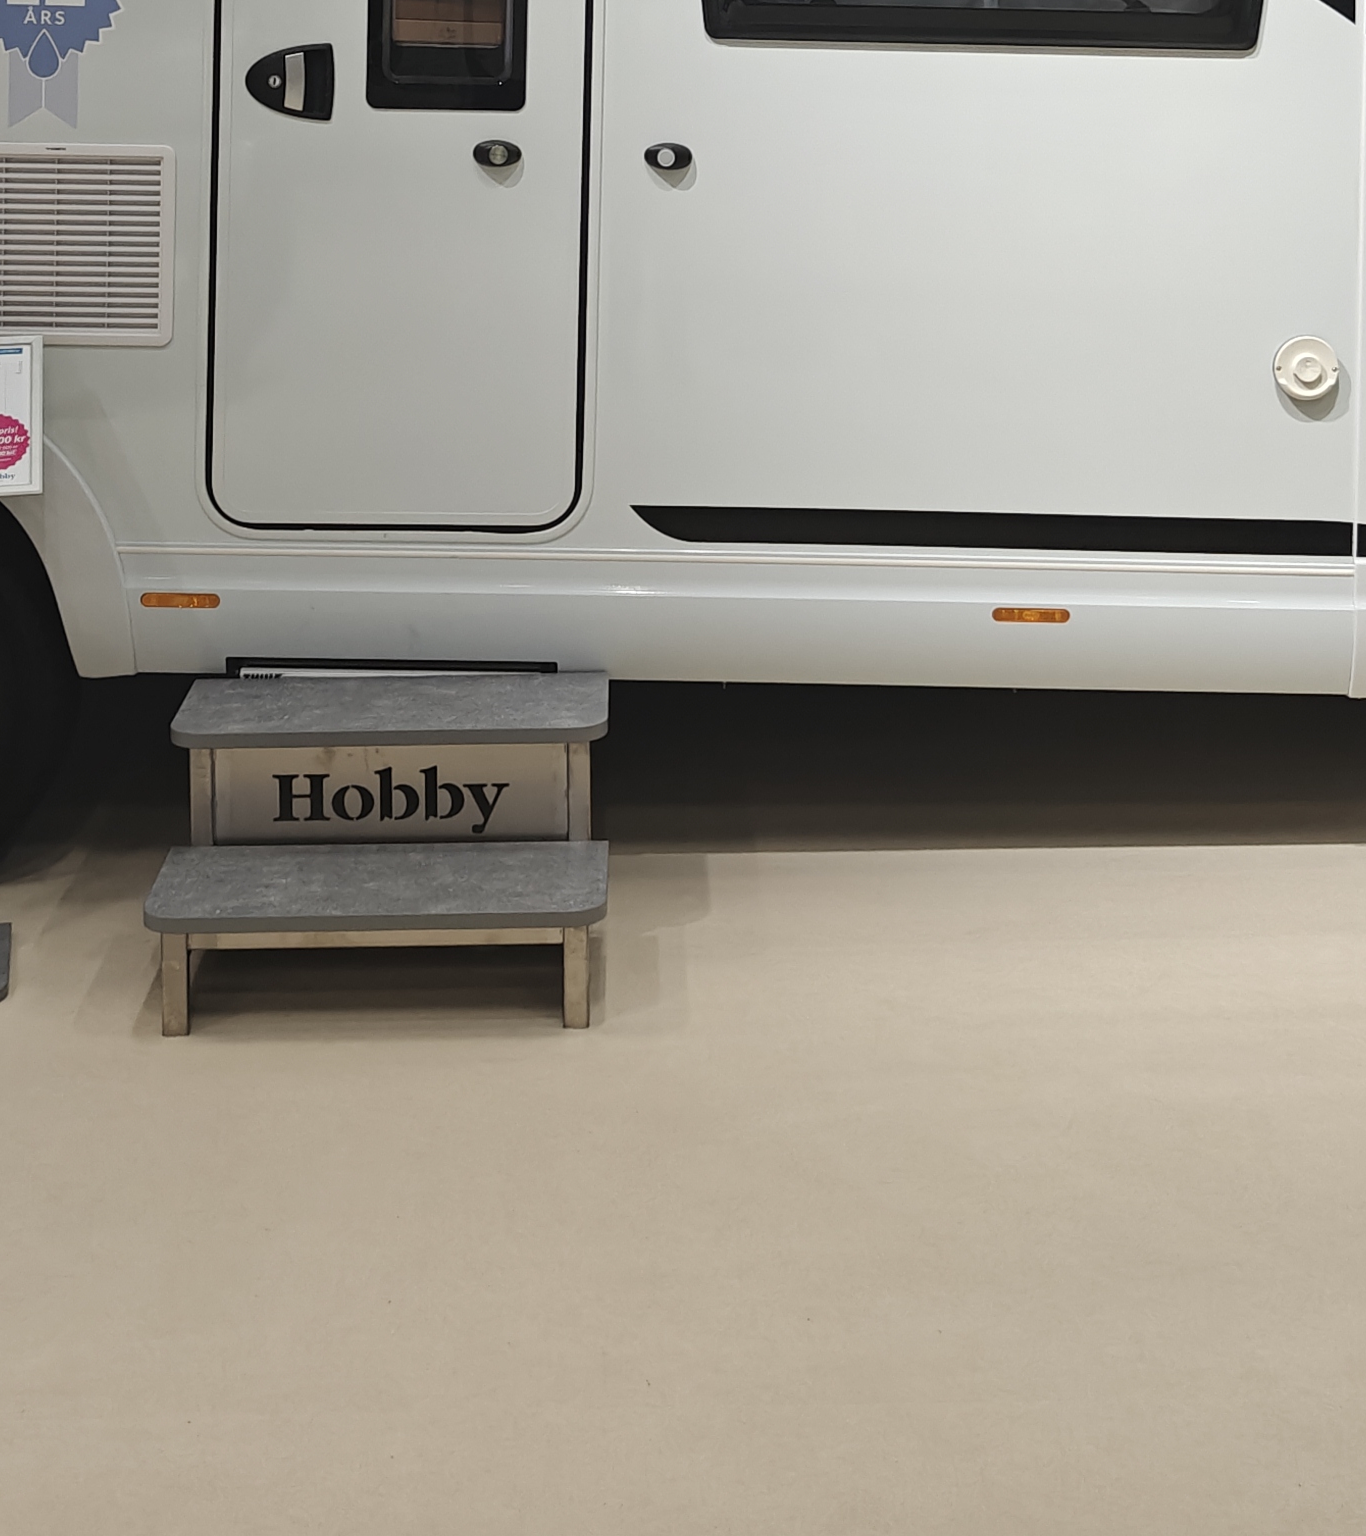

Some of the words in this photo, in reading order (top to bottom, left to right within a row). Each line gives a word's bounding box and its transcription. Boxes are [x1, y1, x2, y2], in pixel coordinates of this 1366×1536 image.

[23, 6, 65, 25] ÅRS
[14, 434, 26, 443] kr
[272, 765, 510, 834] Hobby
